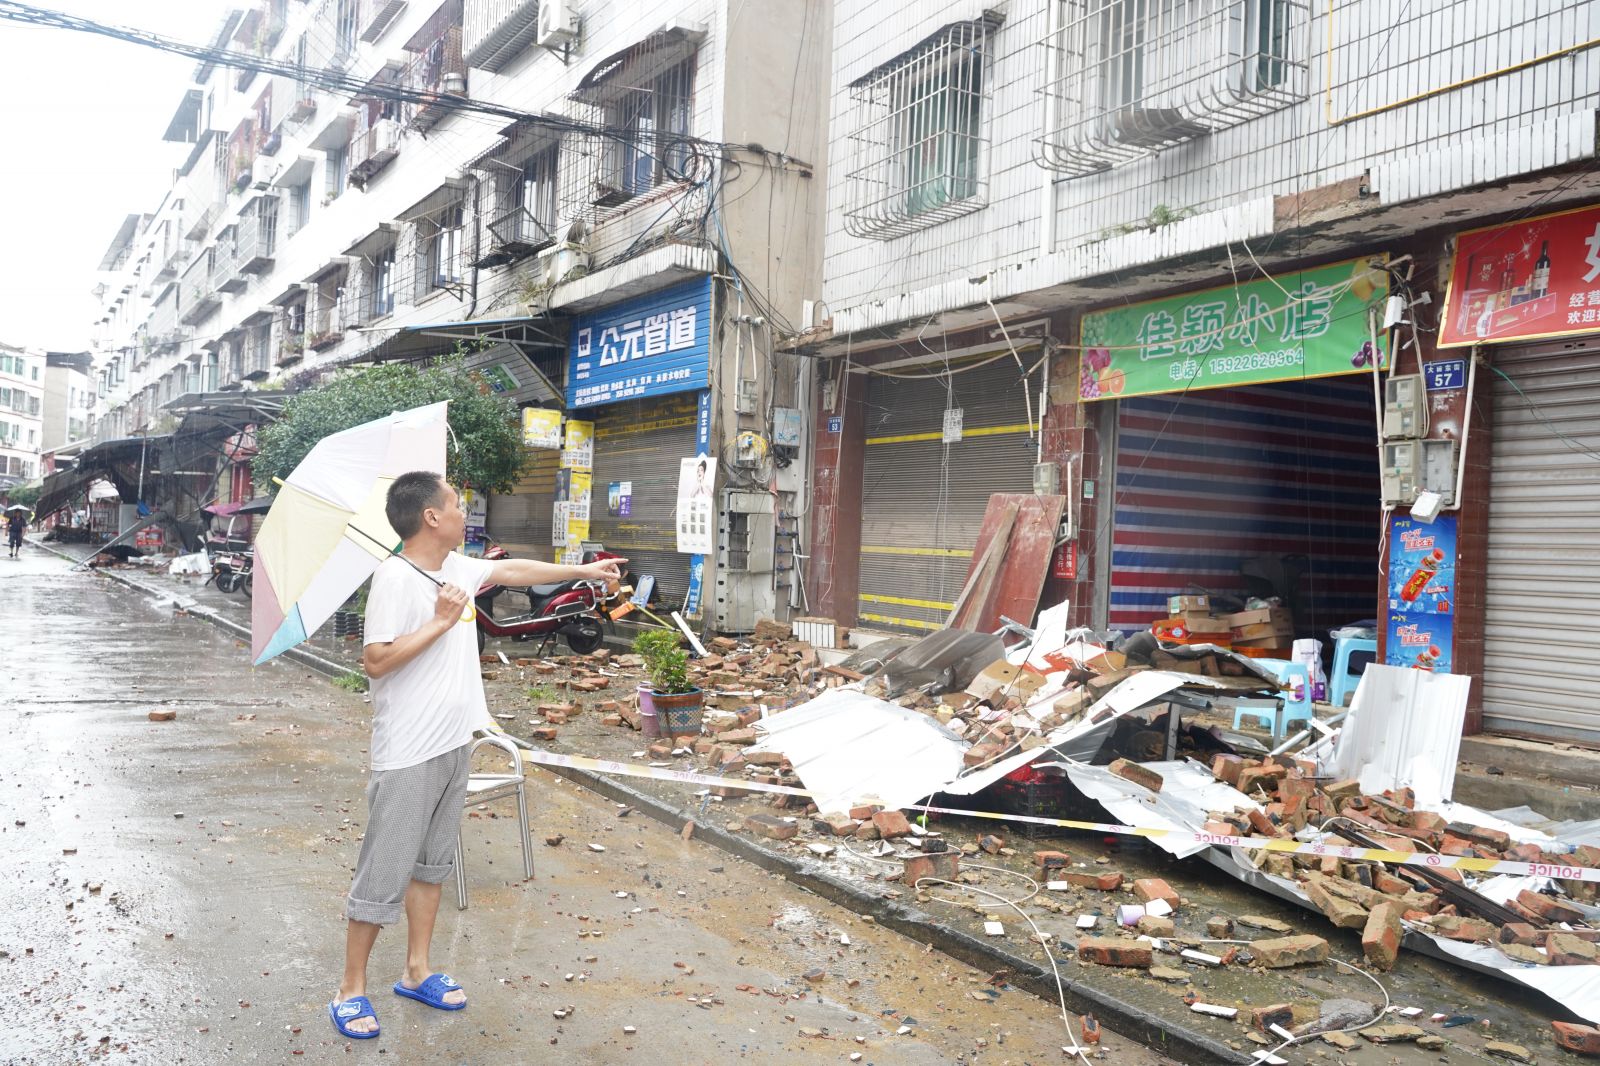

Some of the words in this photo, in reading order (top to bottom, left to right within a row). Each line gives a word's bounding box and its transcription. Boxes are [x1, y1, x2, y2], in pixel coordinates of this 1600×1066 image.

[1136, 282, 1334, 361] 佳颖小店
[1567, 308, 1600, 324] 欢迎
[599, 306, 697, 367] 公元管道
[1434, 373, 1453, 387] 57
[1193, 833, 1239, 846] POLICE
[1528, 864, 1583, 879] POLICE
